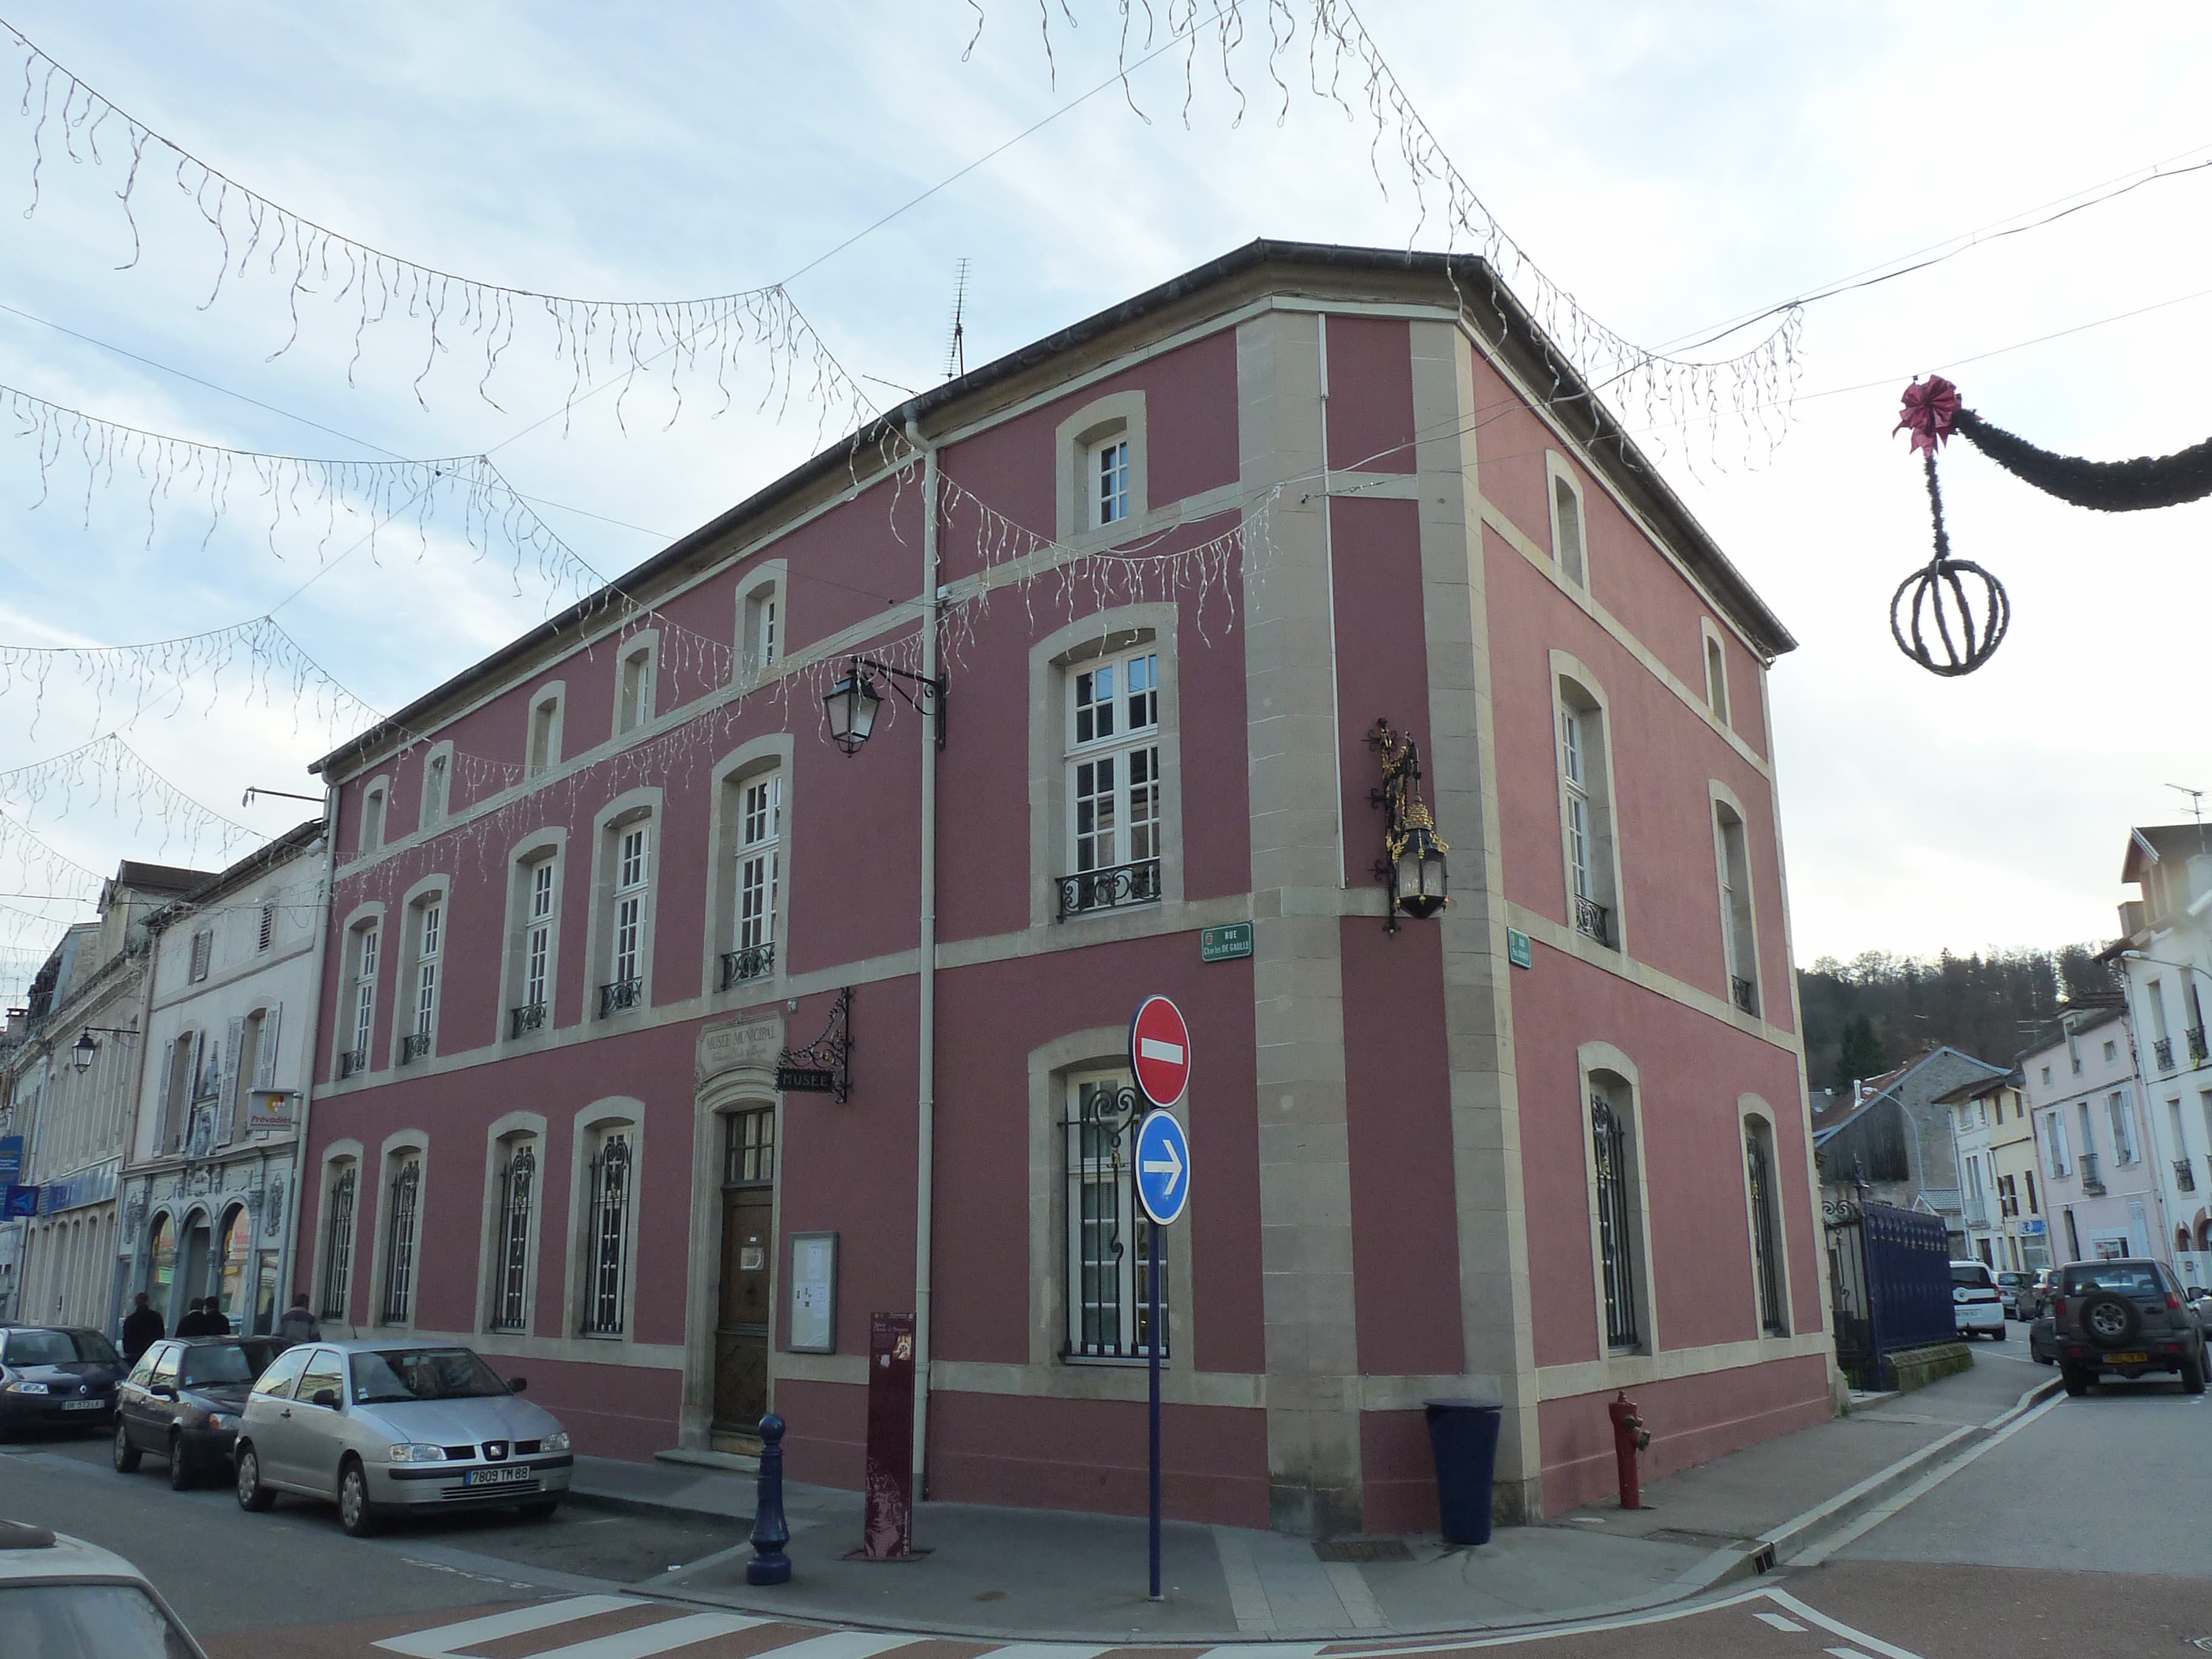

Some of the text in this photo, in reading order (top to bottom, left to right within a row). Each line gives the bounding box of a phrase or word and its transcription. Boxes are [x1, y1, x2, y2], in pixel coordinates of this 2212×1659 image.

[1224, 930, 1238, 940] RUE
[1204, 940, 1249, 956] Charles DE GAULLE
[734, 1025, 776, 1044] MUNICIPAL
[472, 1470, 498, 1483] 7809
[515, 1467, 528, 1479] 88
